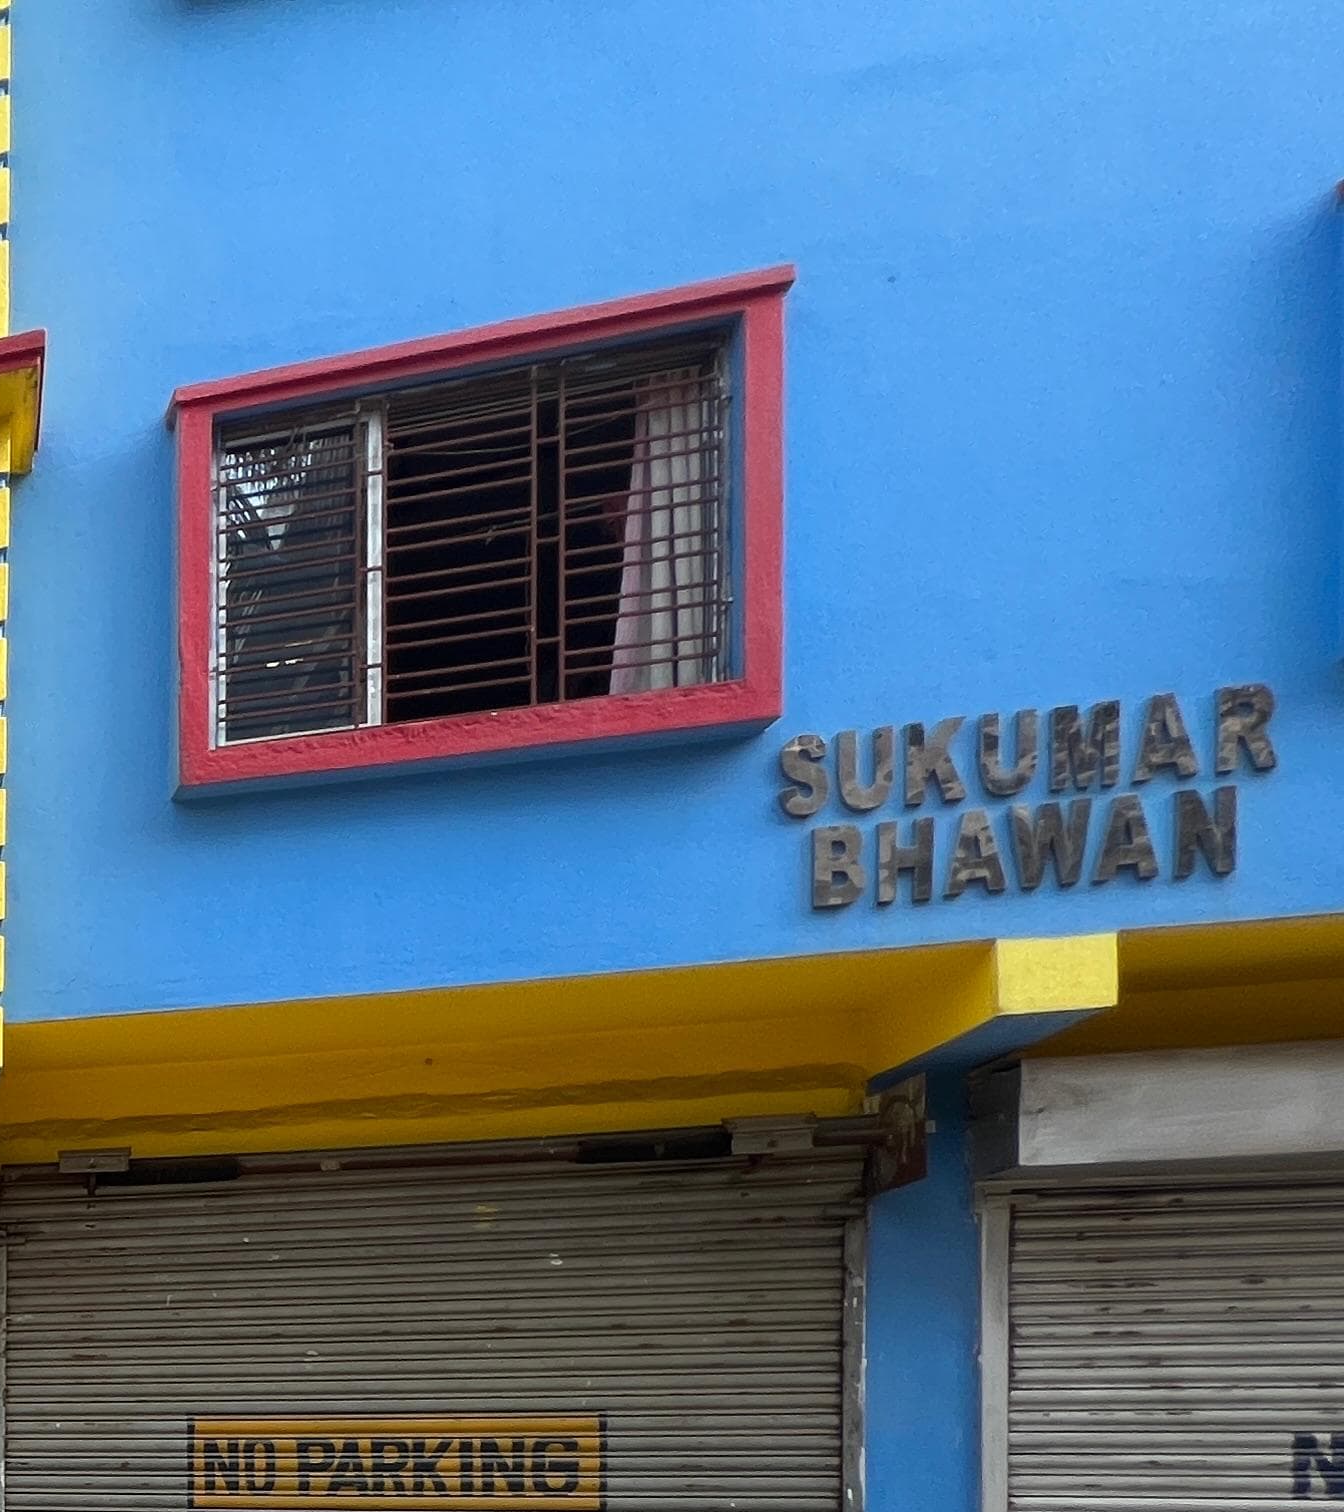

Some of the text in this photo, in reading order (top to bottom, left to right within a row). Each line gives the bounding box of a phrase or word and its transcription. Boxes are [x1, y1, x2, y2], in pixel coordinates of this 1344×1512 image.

[778, 683, 1277, 817] SUKUMAR
[811, 785, 1238, 909] BHAWAN
[203, 1437, 580, 1496] NO PARKING
